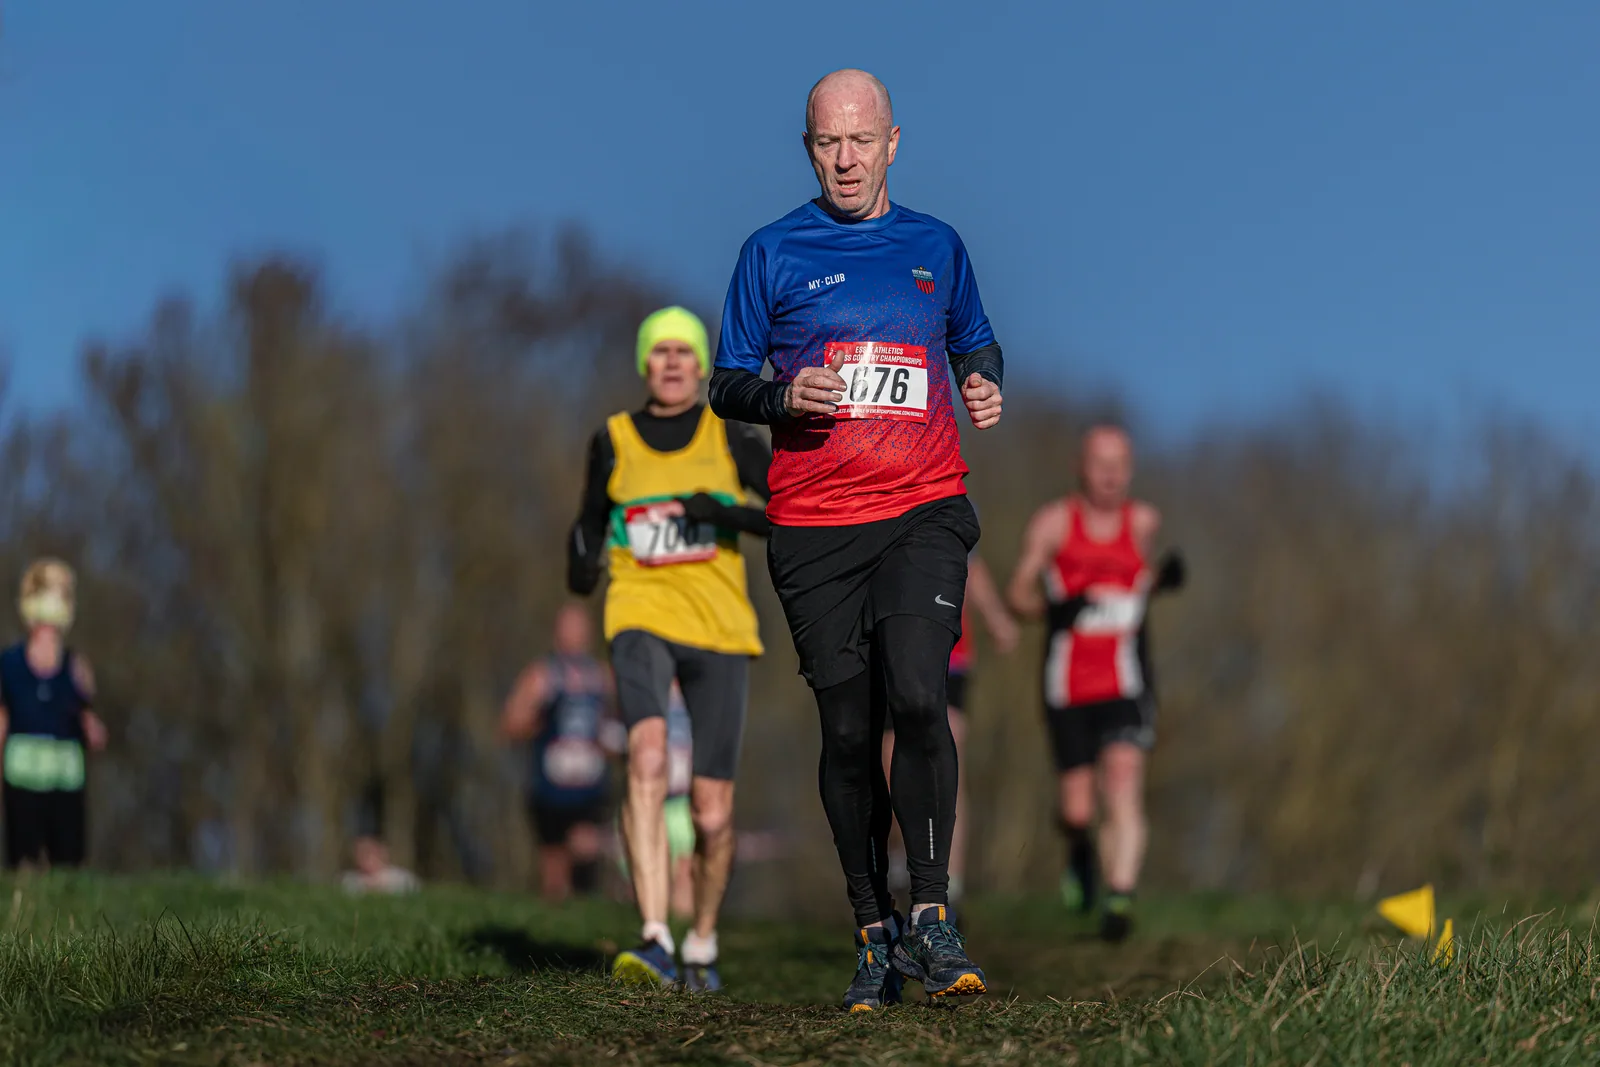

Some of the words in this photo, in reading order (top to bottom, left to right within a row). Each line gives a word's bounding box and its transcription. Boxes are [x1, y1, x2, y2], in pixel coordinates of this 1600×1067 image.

[874, 346, 904, 355] ATHLETICS
[880, 354, 923, 366] CHAMPIONSHIPS
[850, 366, 910, 404] 676
